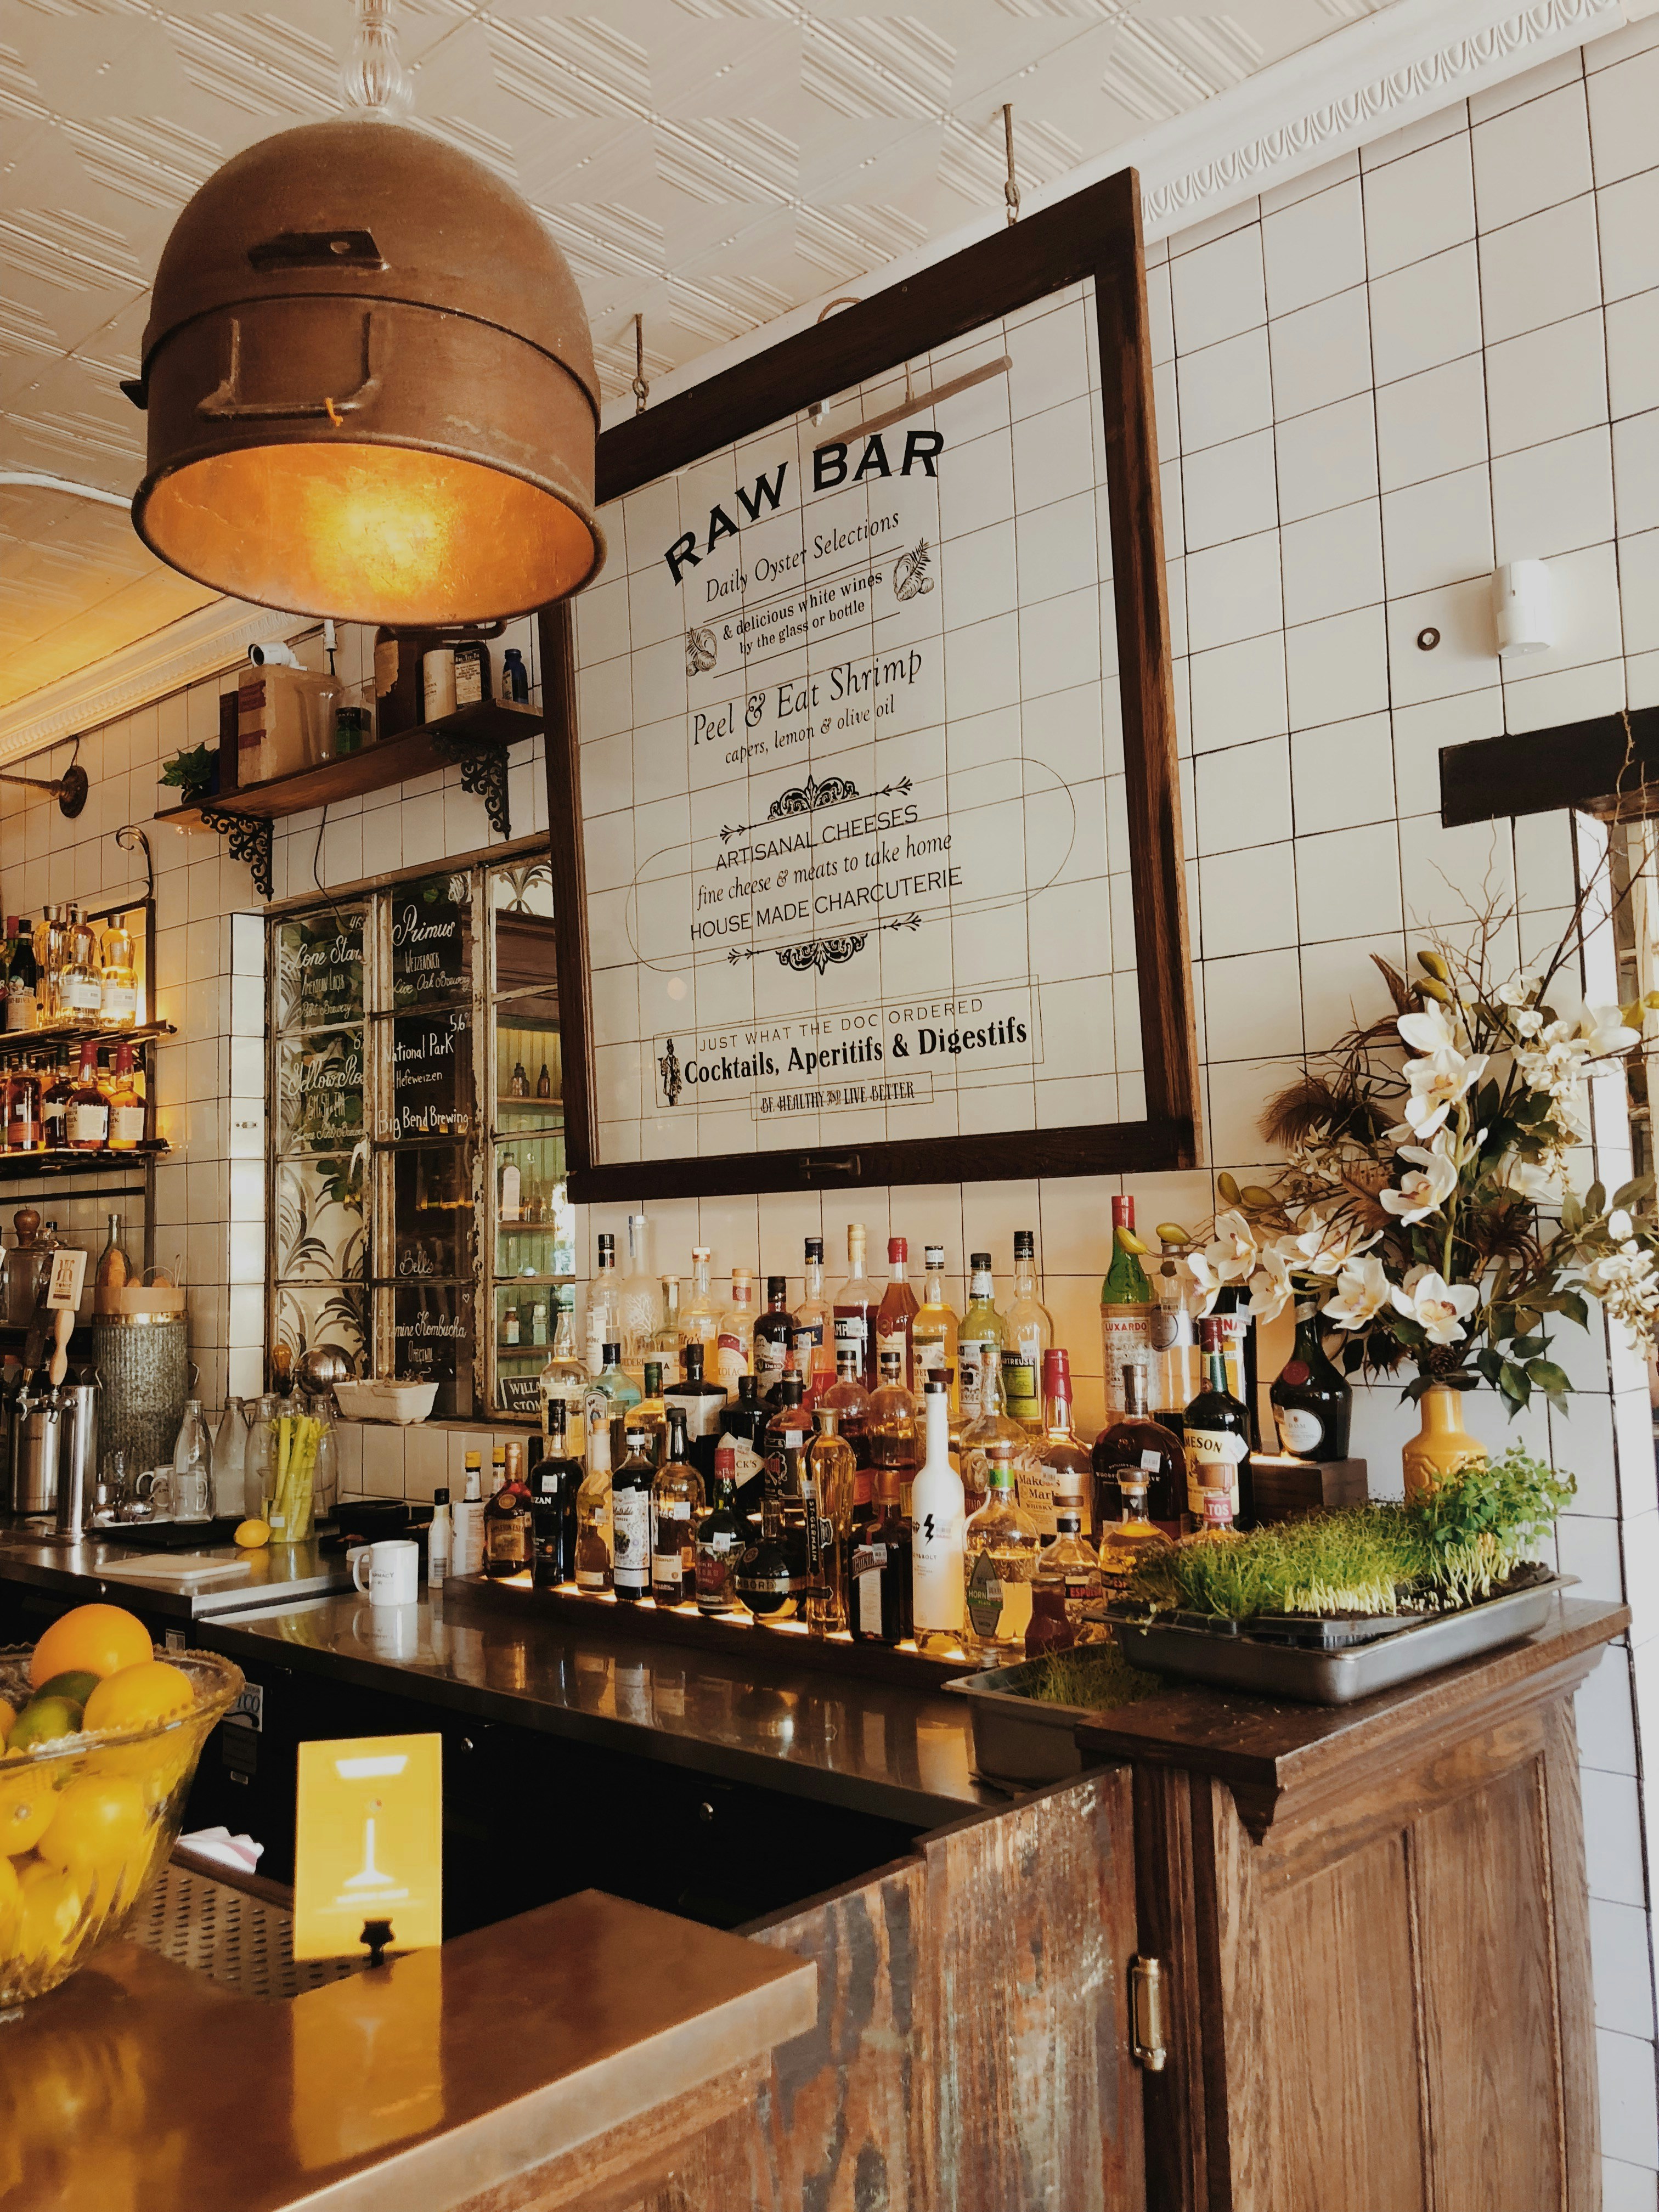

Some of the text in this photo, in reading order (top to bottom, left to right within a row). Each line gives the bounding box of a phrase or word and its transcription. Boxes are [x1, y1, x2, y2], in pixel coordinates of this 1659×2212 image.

[663, 431, 944, 585] RAW BAR
[706, 512, 899, 602] Daily Oyster Selections
[723, 572, 882, 641] & delicious white wines
[740, 600, 865, 654] by the glass or bottle
[693, 649, 922, 746] Peel & Eat Shrimp
[725, 695, 895, 764] capers, lemon & olive oil
[715, 804, 918, 871] ARTISANAL CHEESES
[697, 833, 952, 910] fine cheese & meats to take home
[690, 866, 963, 941] HOUSE MADE CHARCUTERIE
[393, 904, 456, 946] Primus
[285, 935, 363, 972] Lone Star
[393, 970, 472, 995] Live Oak Brewery
[699, 998, 984, 1053] JUST WHAT THE DOC ORDERED
[382, 1034, 426, 1063] National
[684, 1015, 1028, 1085] Cocktails, Aperitifs & Digestifs
[287, 1054, 364, 1097] Yellow Ros
[396, 1069, 444, 1090] Hefeweizen
[760, 1096, 775, 1113] BE
[777, 1091, 825, 1111] HEALTHY
[844, 1086, 866, 1105] LIVE
[870, 1081, 915, 1102] BETTER
[379, 1105, 470, 1141] Big Bend Brewing
[415, 1311, 467, 1339] Kombucha
[1105, 1322, 1147, 1331] LUXARDO
[509, 1381, 541, 1396] WILLA
[513, 1400, 543, 1412] STOM
[1183, 1436, 1223, 1454] MESON
[1206, 1502, 1230, 1516] TOS
